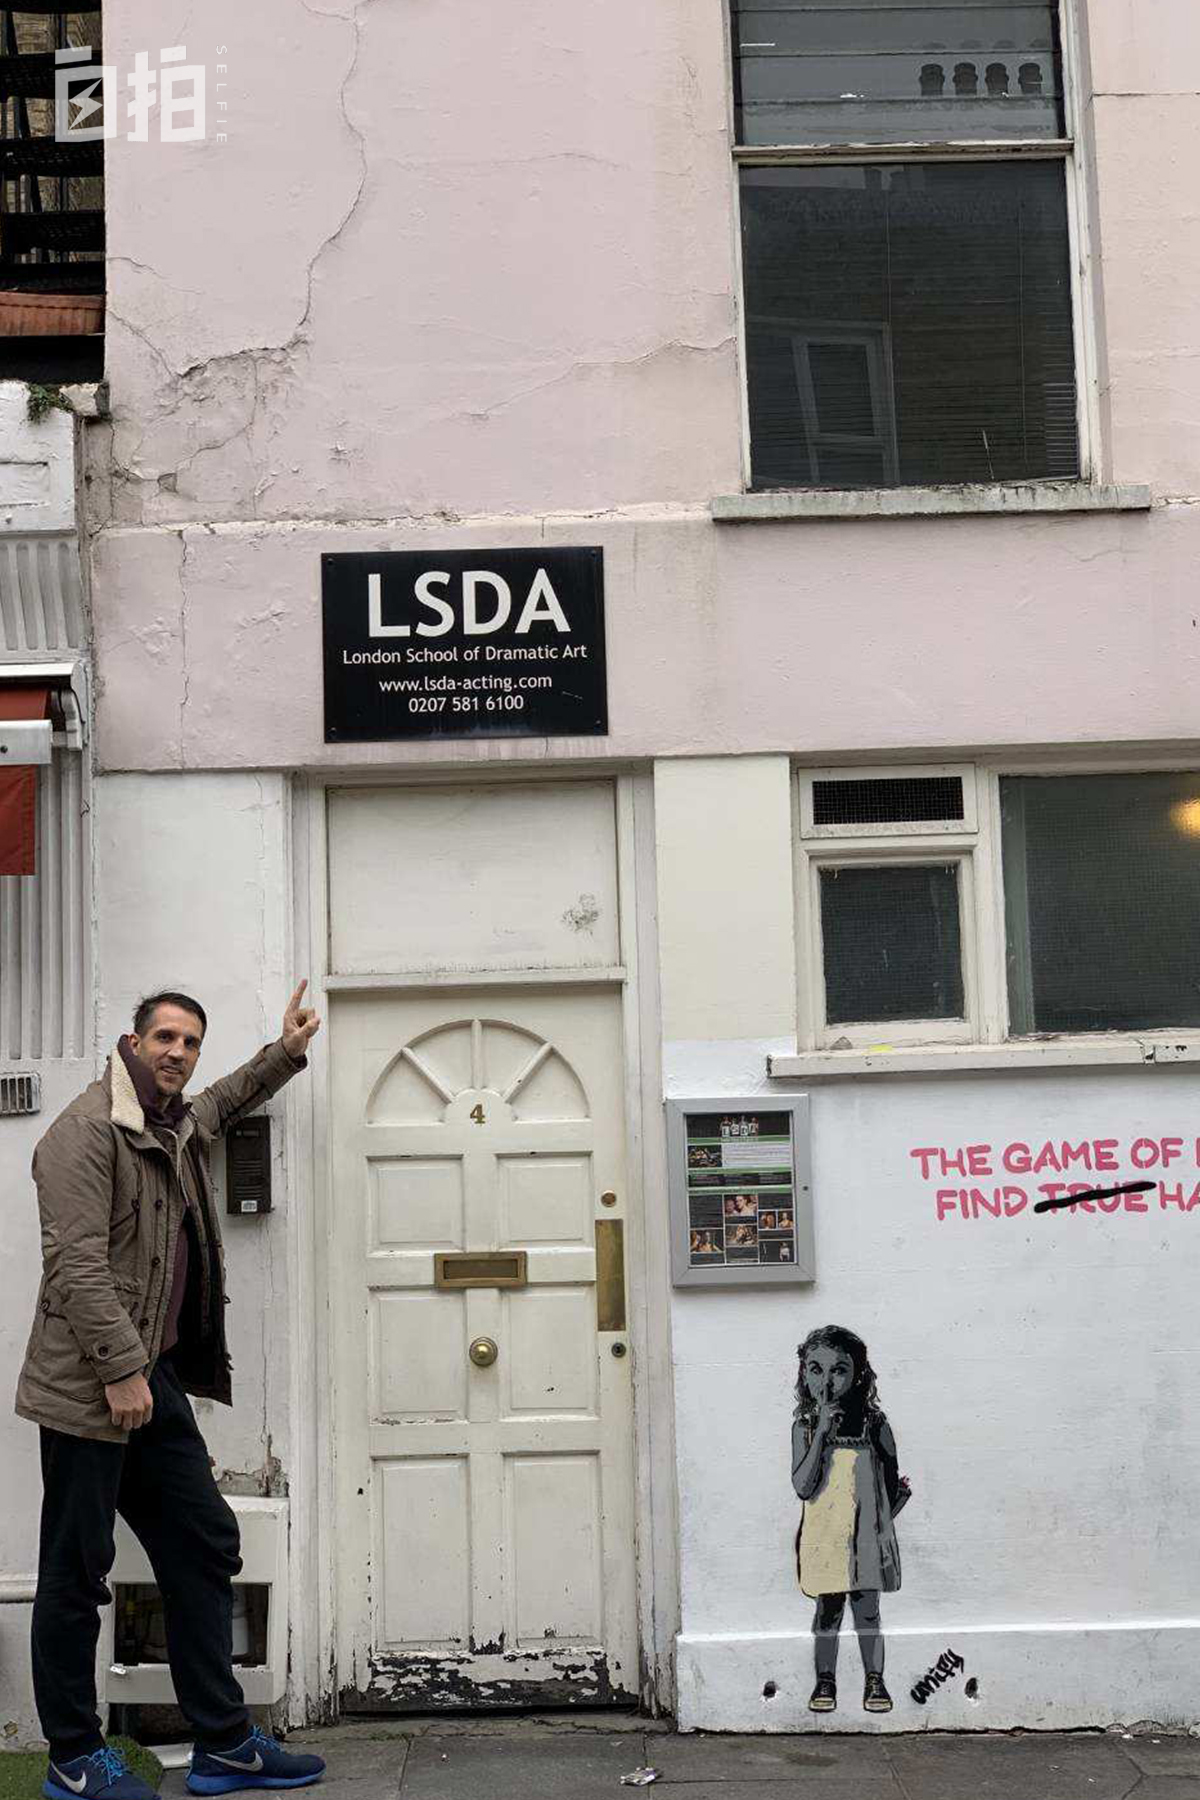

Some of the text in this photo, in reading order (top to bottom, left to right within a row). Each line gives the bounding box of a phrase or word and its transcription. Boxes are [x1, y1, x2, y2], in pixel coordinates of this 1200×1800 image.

[368, 568, 571, 638] LSDA
[343, 644, 587, 665] London School of Dramatic Art
[379, 675, 552, 691] www.lsda-acting.com
[409, 695, 524, 713] 0207 581 6100
[470, 1104, 485, 1124] 4
[910, 1145, 993, 1179] THE
[1003, 1139, 1119, 1173] GAME
[1130, 1137, 1184, 1169] OF
[936, 1186, 1028, 1220] FIND
[1037, 1182, 1148, 1213] TRUE
